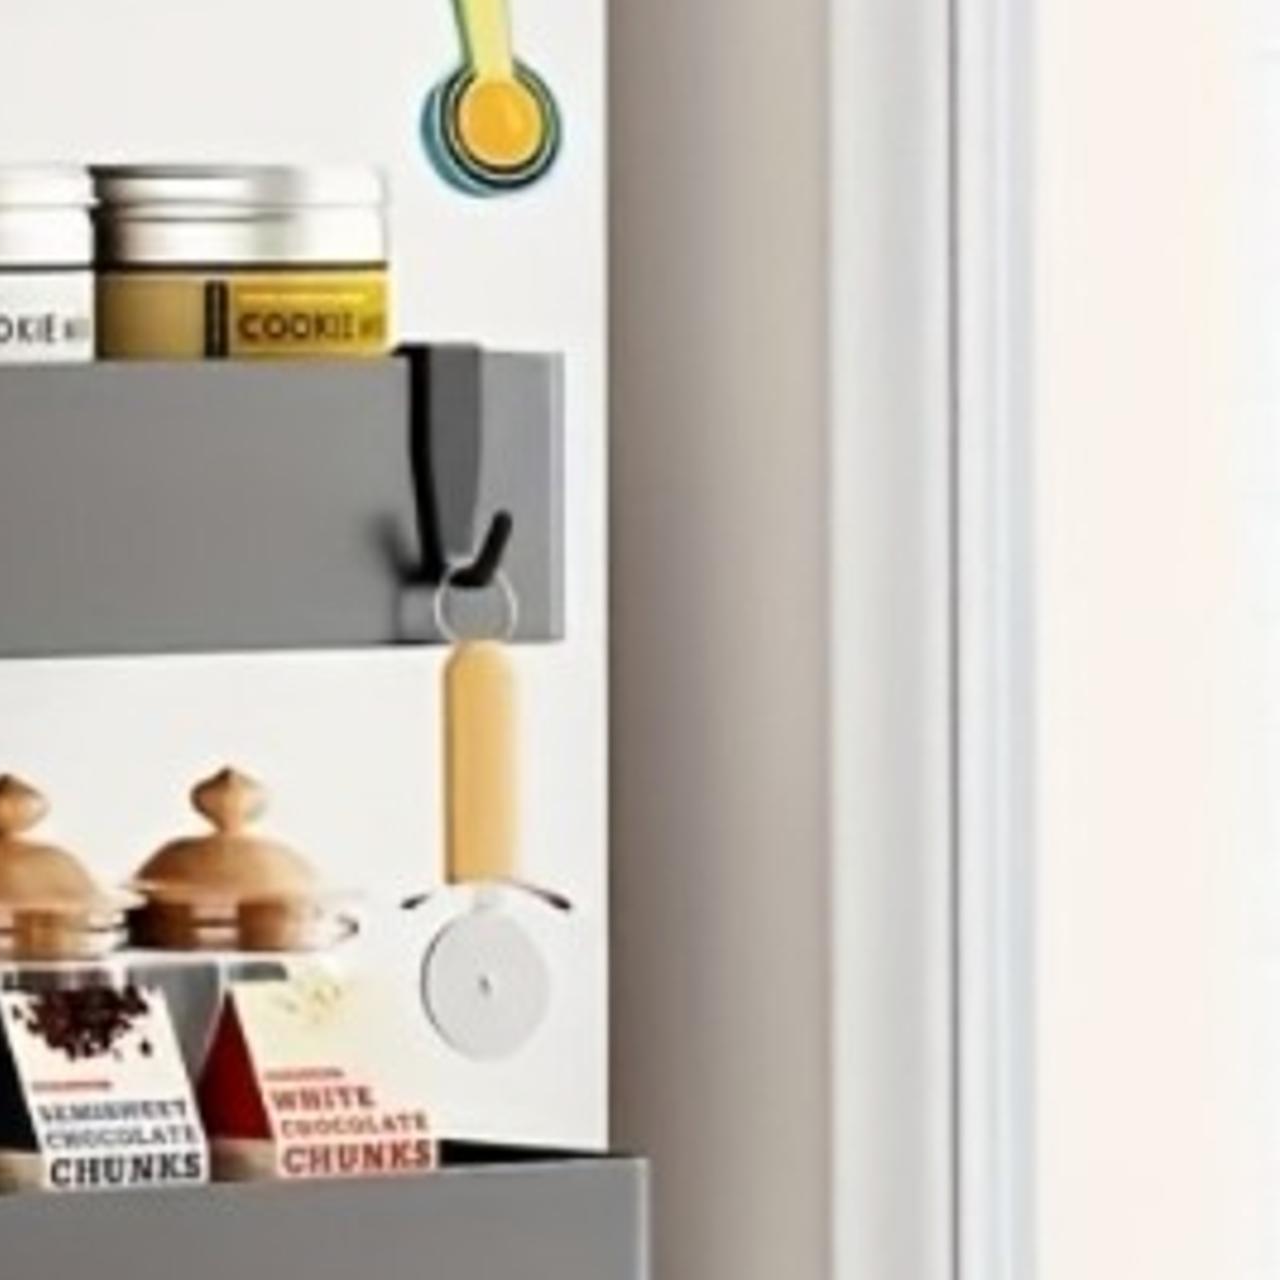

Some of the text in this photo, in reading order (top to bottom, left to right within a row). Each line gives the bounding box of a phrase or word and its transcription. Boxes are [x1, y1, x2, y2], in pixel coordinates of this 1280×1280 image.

[271, 1086, 373, 1110] WHITE
[46, 1126, 198, 1150] CHOCOLATE
[281, 1112, 427, 1139] CHOCOLATE
[51, 1153, 200, 1184] CHUNKS
[282, 1140, 431, 1173] CHUNKS
